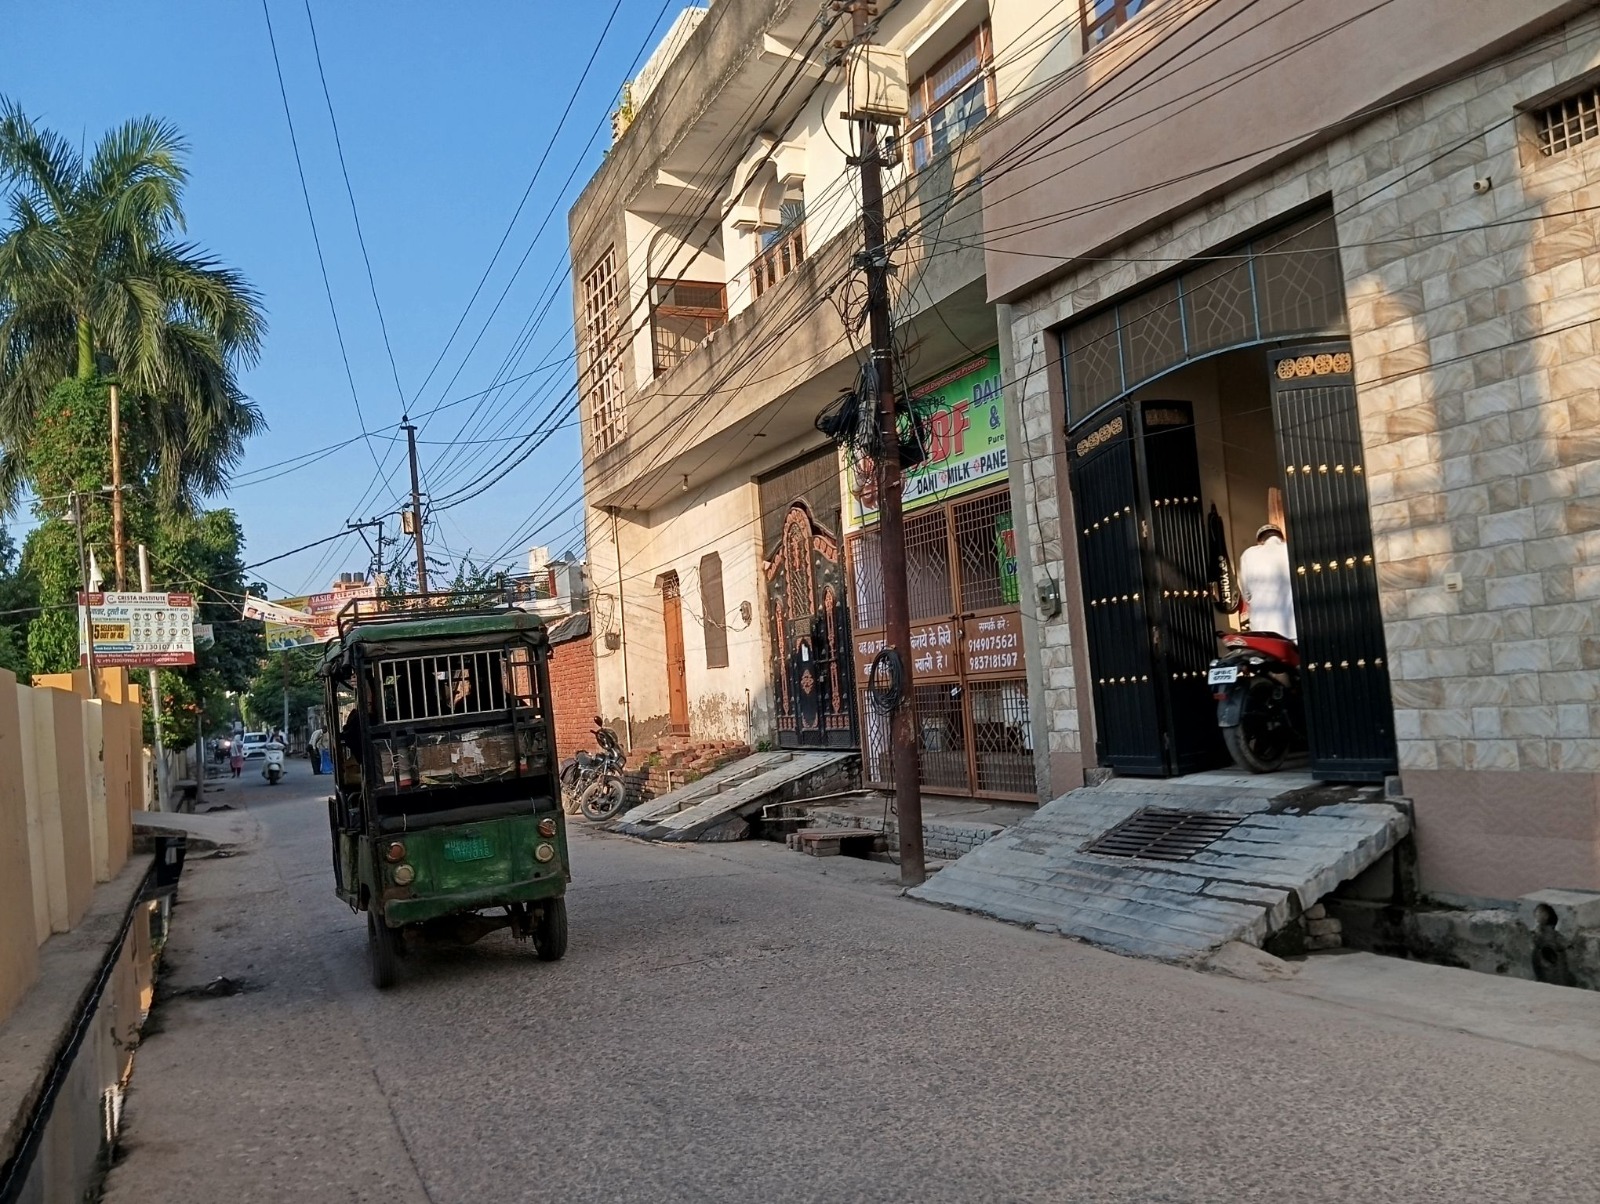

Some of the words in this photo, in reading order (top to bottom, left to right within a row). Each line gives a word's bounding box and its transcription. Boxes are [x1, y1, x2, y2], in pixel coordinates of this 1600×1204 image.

[961, 358, 986, 374] Products
[988, 434, 1005, 445] Pure
[947, 461, 971, 485] MILK
[1220, 572, 1231, 604] YONEX
[311, 594, 331, 603] YASIR
[929, 627, 937, 647] के
[968, 633, 1017, 652] 9149075621
[914, 652, 933, 673] खाली
[969, 651, 1018, 670] 9837181507
